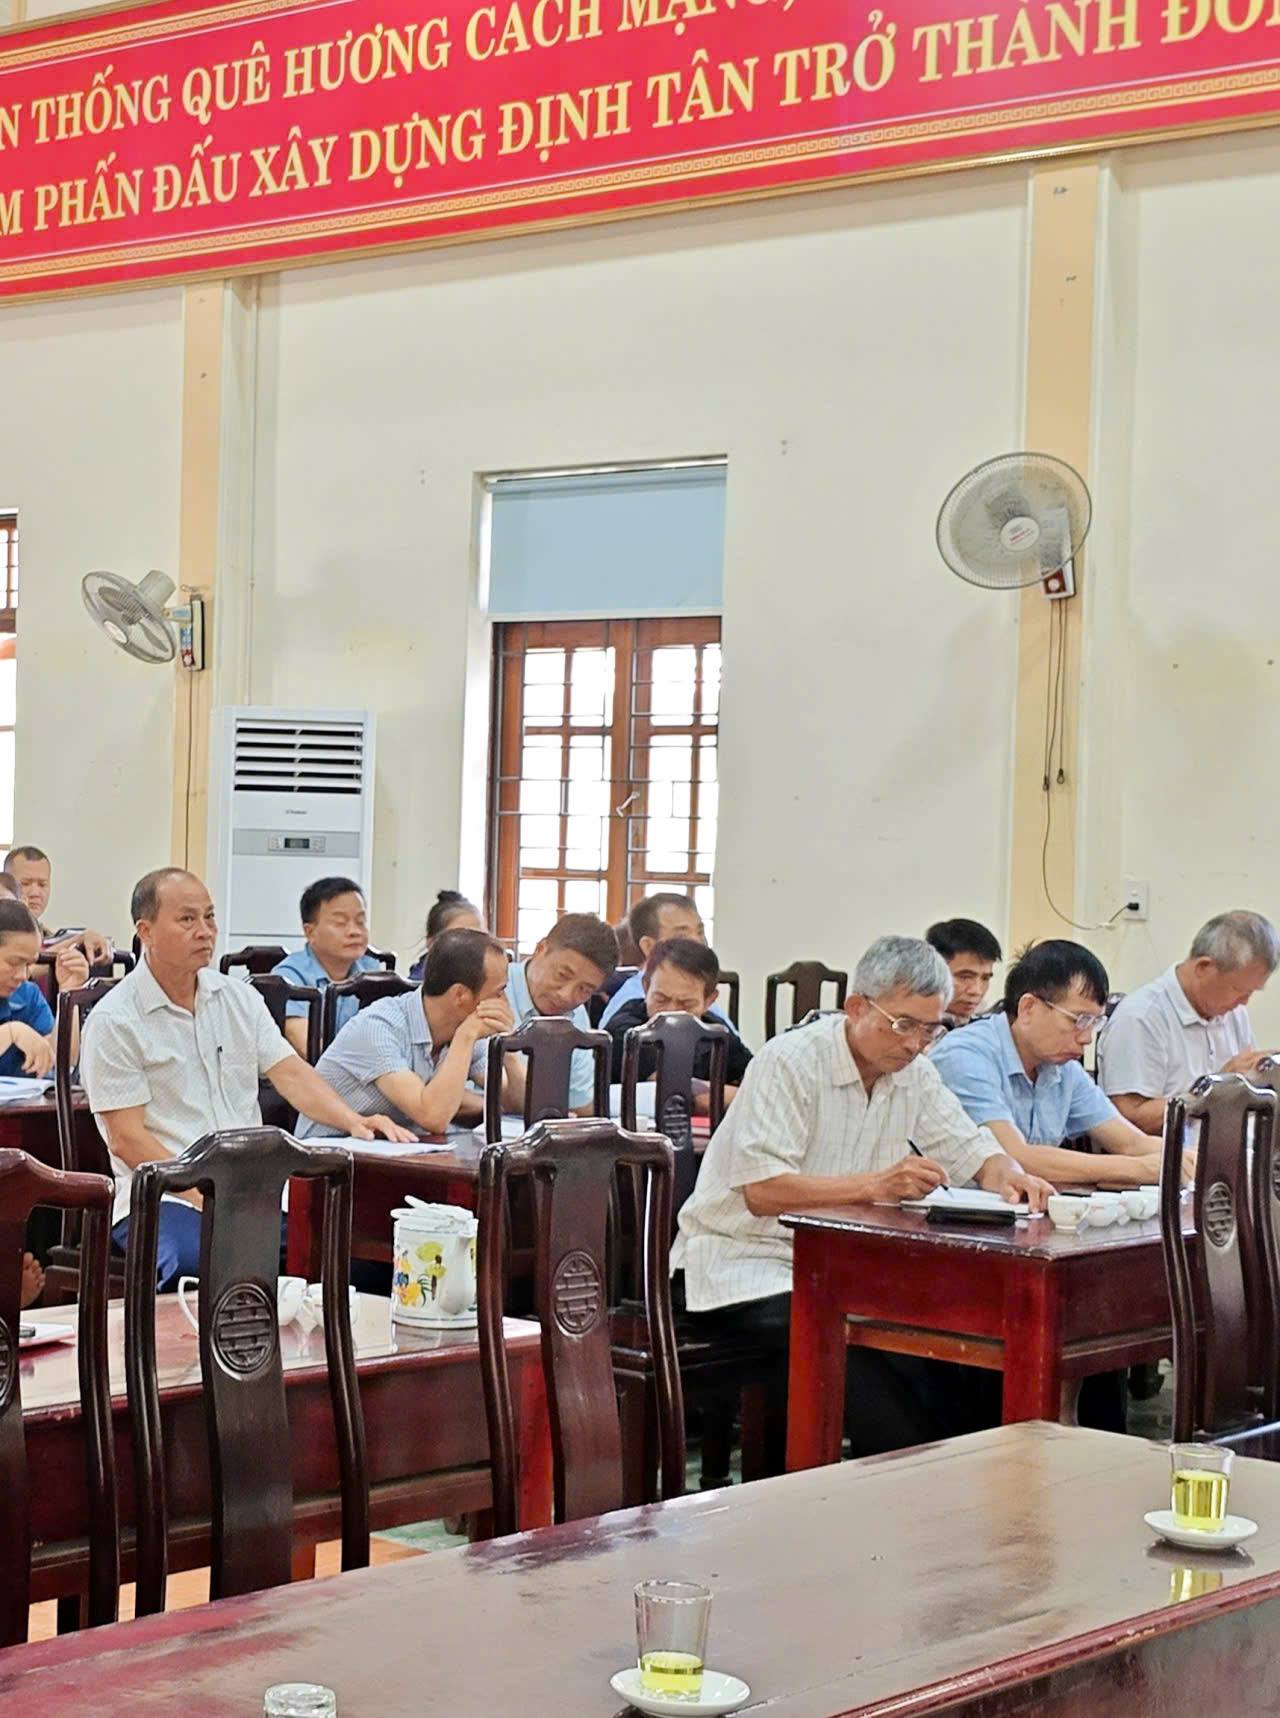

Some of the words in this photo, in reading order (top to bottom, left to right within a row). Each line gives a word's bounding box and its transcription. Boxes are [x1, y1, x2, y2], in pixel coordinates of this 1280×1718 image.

[31, 64, 172, 144] THỐNG
[182, 40, 271, 125] QUÊ
[283, 16, 452, 98] HƯƠNG
[34, 152, 144, 231] PHẤN
[152, 135, 242, 212] ĐẤU
[249, 125, 339, 197] XÂY
[348, 108, 486, 189] DỰNG
[498, 80, 633, 163] ĐỊNH
[646, 48, 760, 129] TÂN
[773, 9, 897, 107] TRỞ
